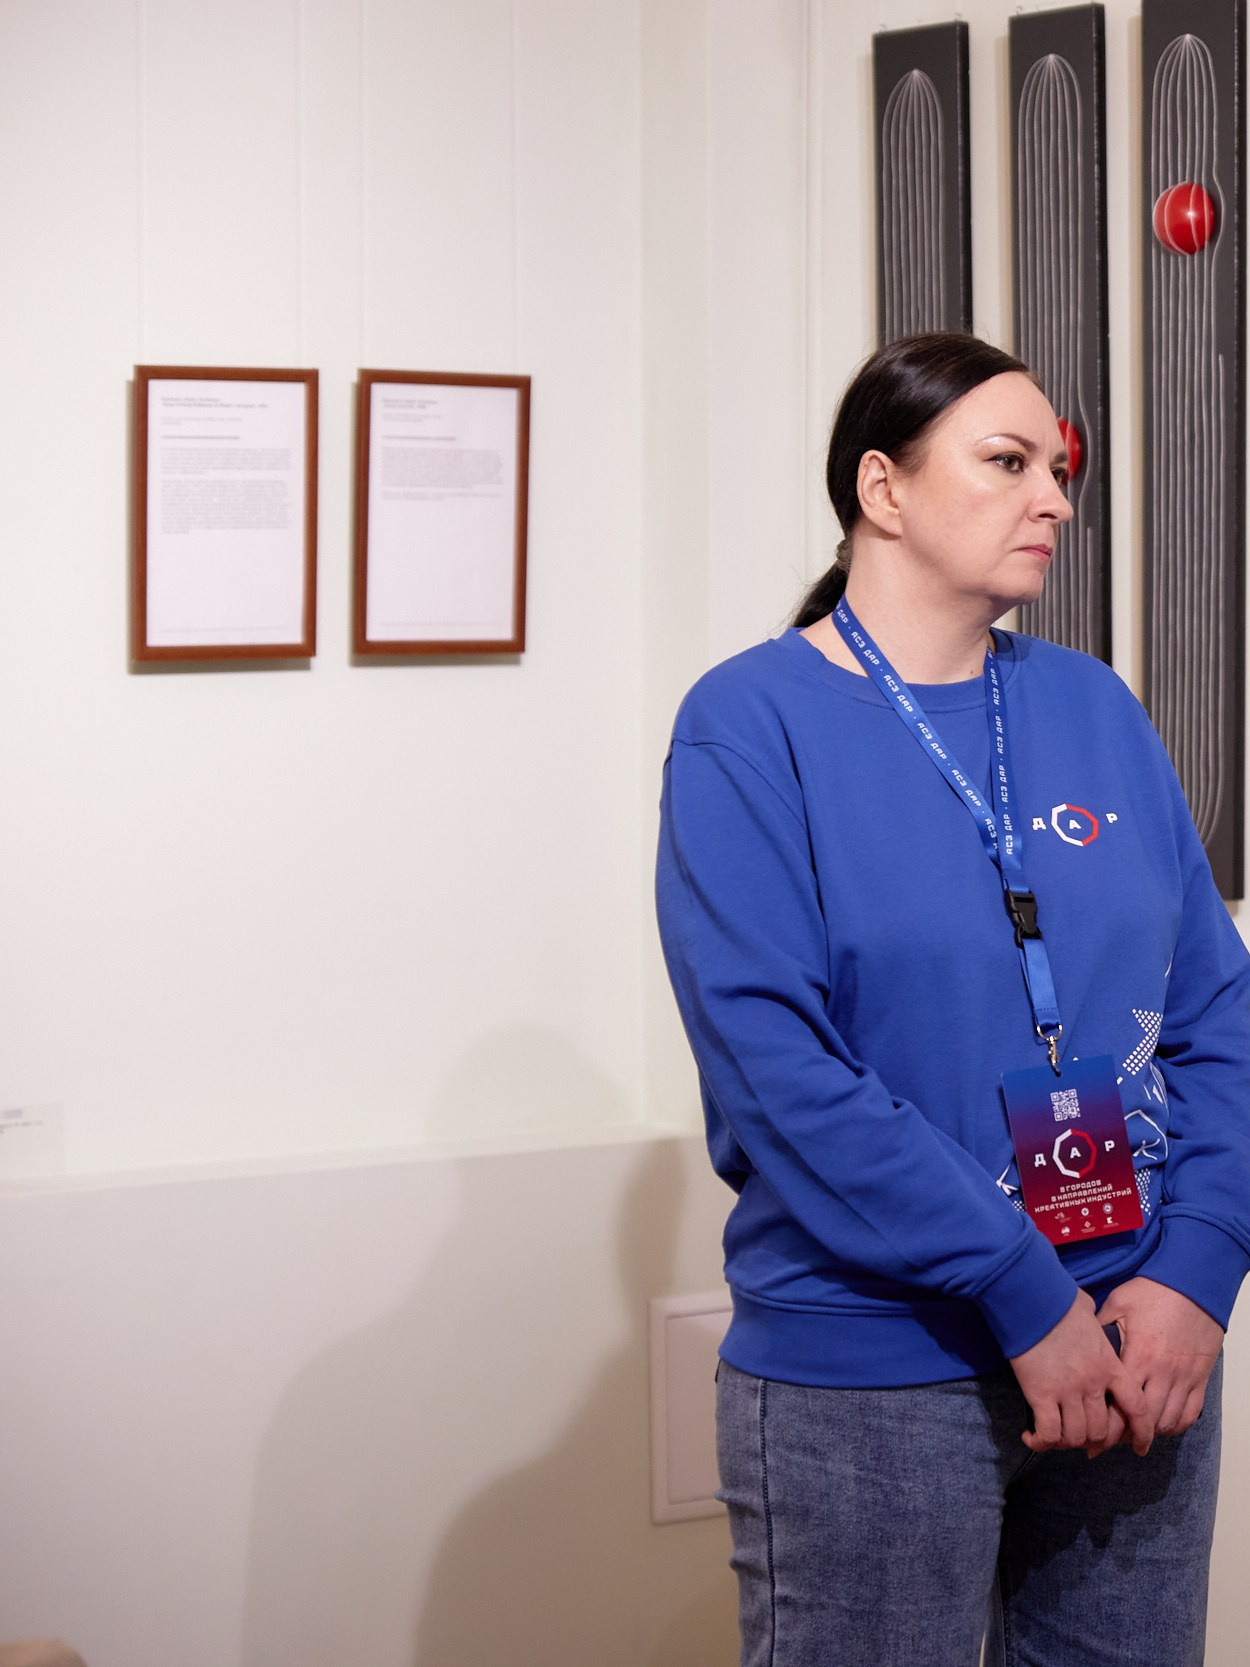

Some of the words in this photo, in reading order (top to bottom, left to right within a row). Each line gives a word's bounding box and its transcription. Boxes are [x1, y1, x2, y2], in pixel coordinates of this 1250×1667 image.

[990, 668, 998, 685] ДАР
[863, 649, 880, 665] ДАР
[897, 695, 913, 712] ДАР
[930, 742, 947, 760] ДАР
[965, 789, 981, 806] ДАР
[995, 716, 1003, 733] ДАР
[999, 765, 1007, 782] ДАР
[1004, 814, 1012, 830] ДАР
[1057, 1184, 1113, 1200] НАПРАВЛЕНИЙ
[1066, 1179, 1101, 1191] ГОРОДОВ
[1035, 1199, 1086, 1213] КРЕАТИВНЫХ
[1087, 1188, 1132, 1203] ИНДУСТРИЙ
